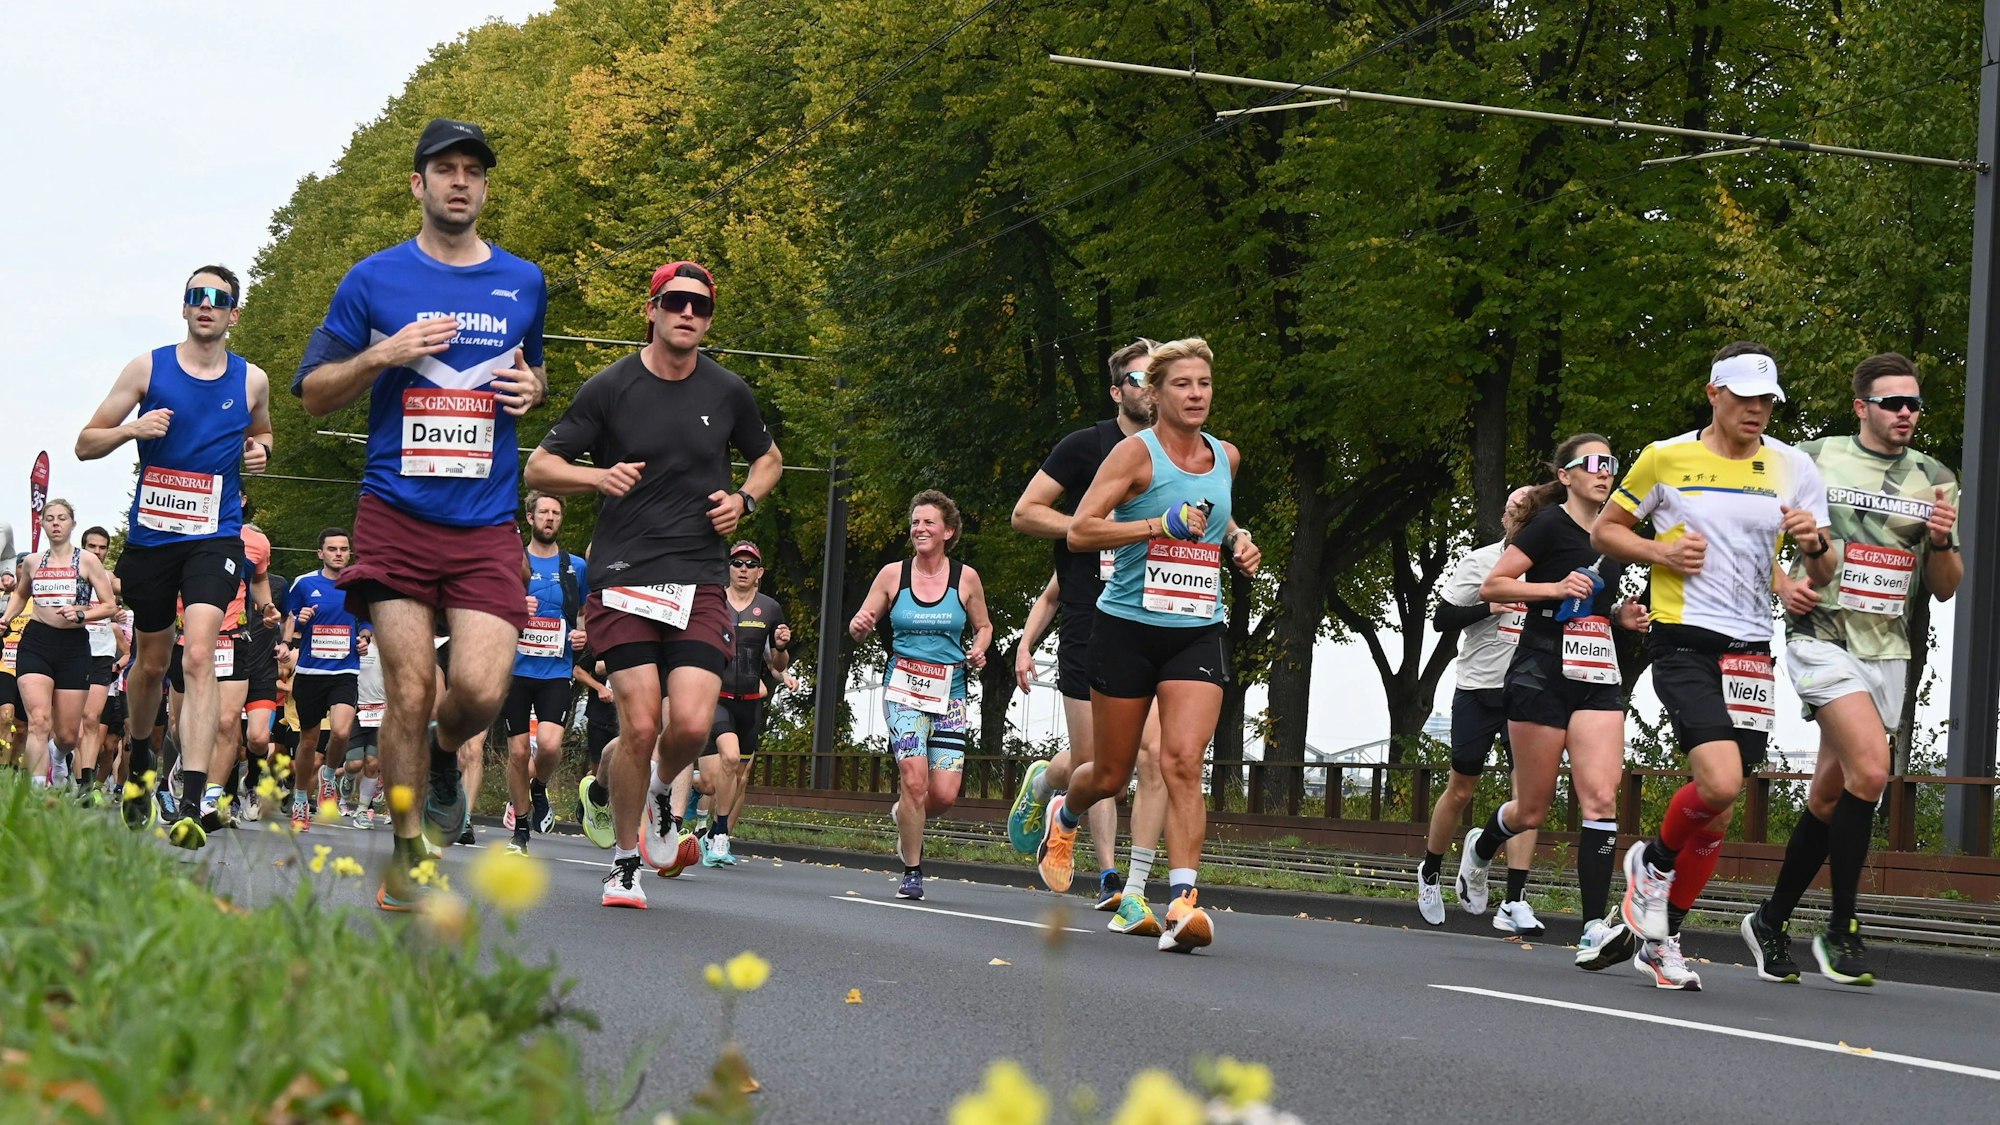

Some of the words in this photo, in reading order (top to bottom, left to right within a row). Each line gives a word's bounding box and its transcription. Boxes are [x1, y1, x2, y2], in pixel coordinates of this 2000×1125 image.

[425, 396, 493, 413] GENERALI
[412, 423, 477, 444] David
[484, 426, 493, 444] 776
[160, 474, 211, 490] GENERALI
[32, 490, 46, 512] 35
[145, 491, 197, 511] Julian
[202, 496, 211, 514] 5213
[1828, 488, 1934, 519] SPORTKAMERAD
[1169, 546, 1220, 563] GENERALI
[1864, 551, 1915, 567] GENERALI
[1147, 566, 1213, 589] Yvonne
[1843, 569, 1870, 585] Erik
[1873, 574, 1903, 588] Sven
[33, 583, 70, 591] Caroline
[527, 619, 560, 628] GENERALI
[913, 612, 953, 620] REFRATH
[312, 638, 346, 646] Maximilian
[908, 662, 945, 677] GENERALI
[905, 674, 931, 689] T544
[1728, 681, 1767, 703] Niels
